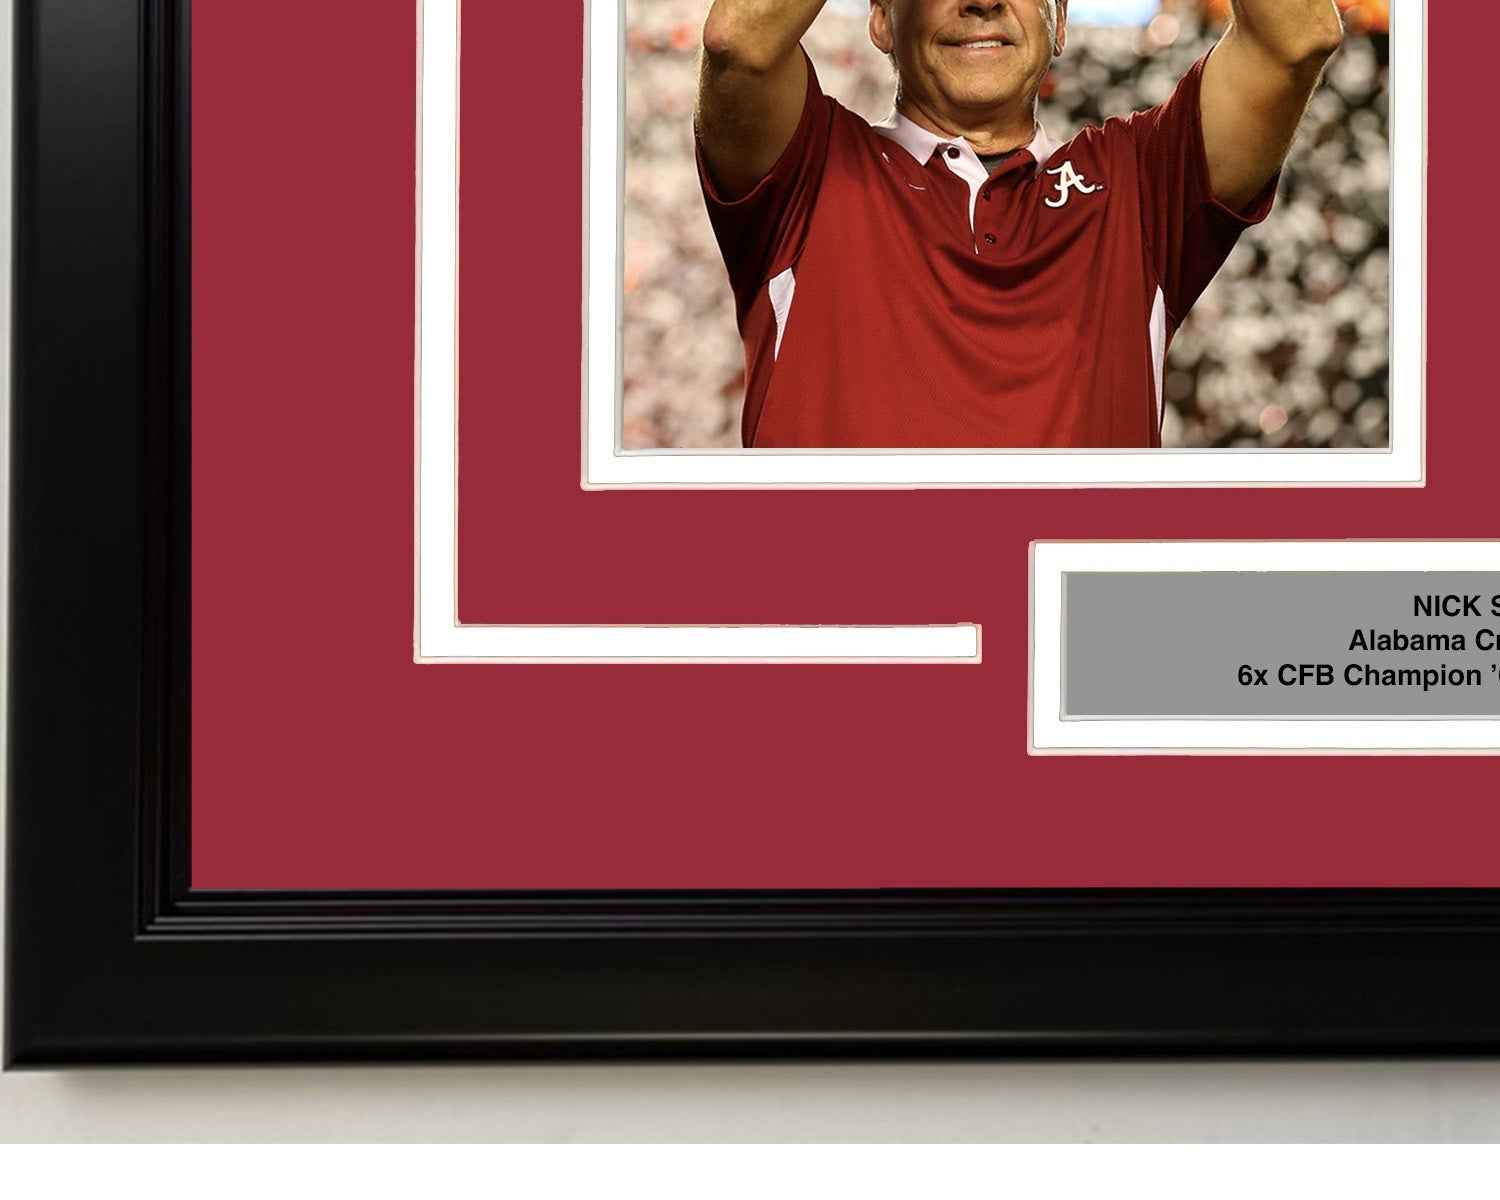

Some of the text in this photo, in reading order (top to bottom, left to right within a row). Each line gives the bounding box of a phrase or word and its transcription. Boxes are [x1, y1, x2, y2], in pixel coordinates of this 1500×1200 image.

[1044, 160, 1096, 208] A
[1412, 593, 1483, 618] NICK
[1347, 627, 1467, 653] Alabama
[1236, 663, 1270, 687] 6x
[1276, 662, 1336, 688] CFB
[1342, 662, 1483, 693] Champion
